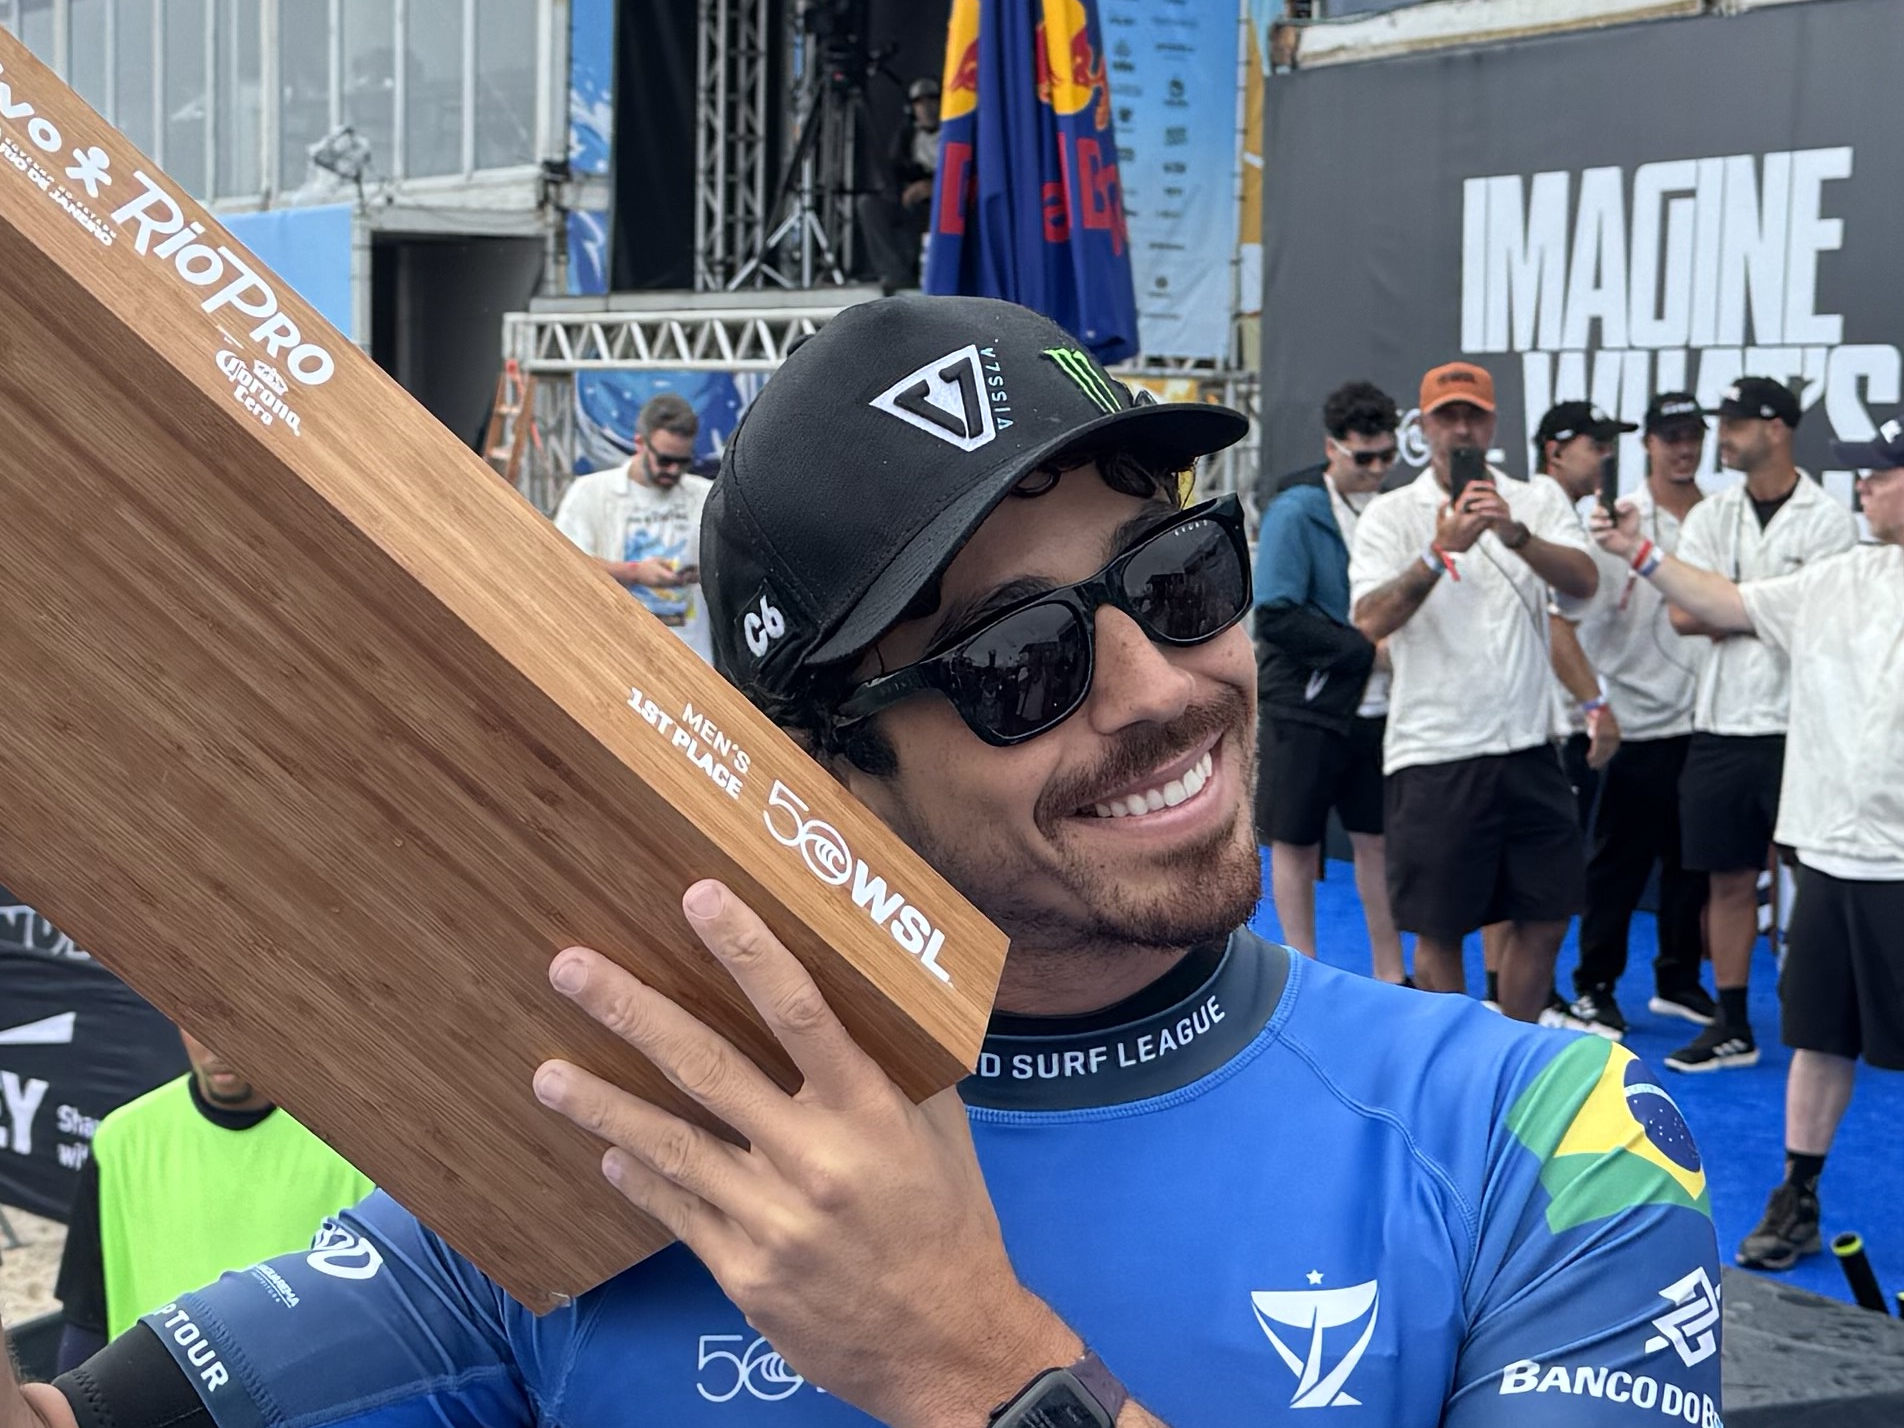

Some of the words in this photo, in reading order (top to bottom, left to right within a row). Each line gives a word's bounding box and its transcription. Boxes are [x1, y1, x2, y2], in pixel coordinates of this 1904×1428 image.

[1460, 146, 1854, 354] IMAGINE
[215, 349, 301, 437] Corona
[233, 384, 274, 426] Cero
[626, 687, 676, 739] 1ST
[671, 734, 744, 801] PLACE
[681, 702, 752, 774] MEN'S
[851, 858, 954, 989] WSL
[1012, 1045, 1108, 1080] SURF
[1118, 995, 1226, 1069] LEAGUE
[163, 1309, 230, 1393] TOUR
[1499, 1359, 1657, 1409] BANCO
[1660, 1384, 1701, 1424] DO
